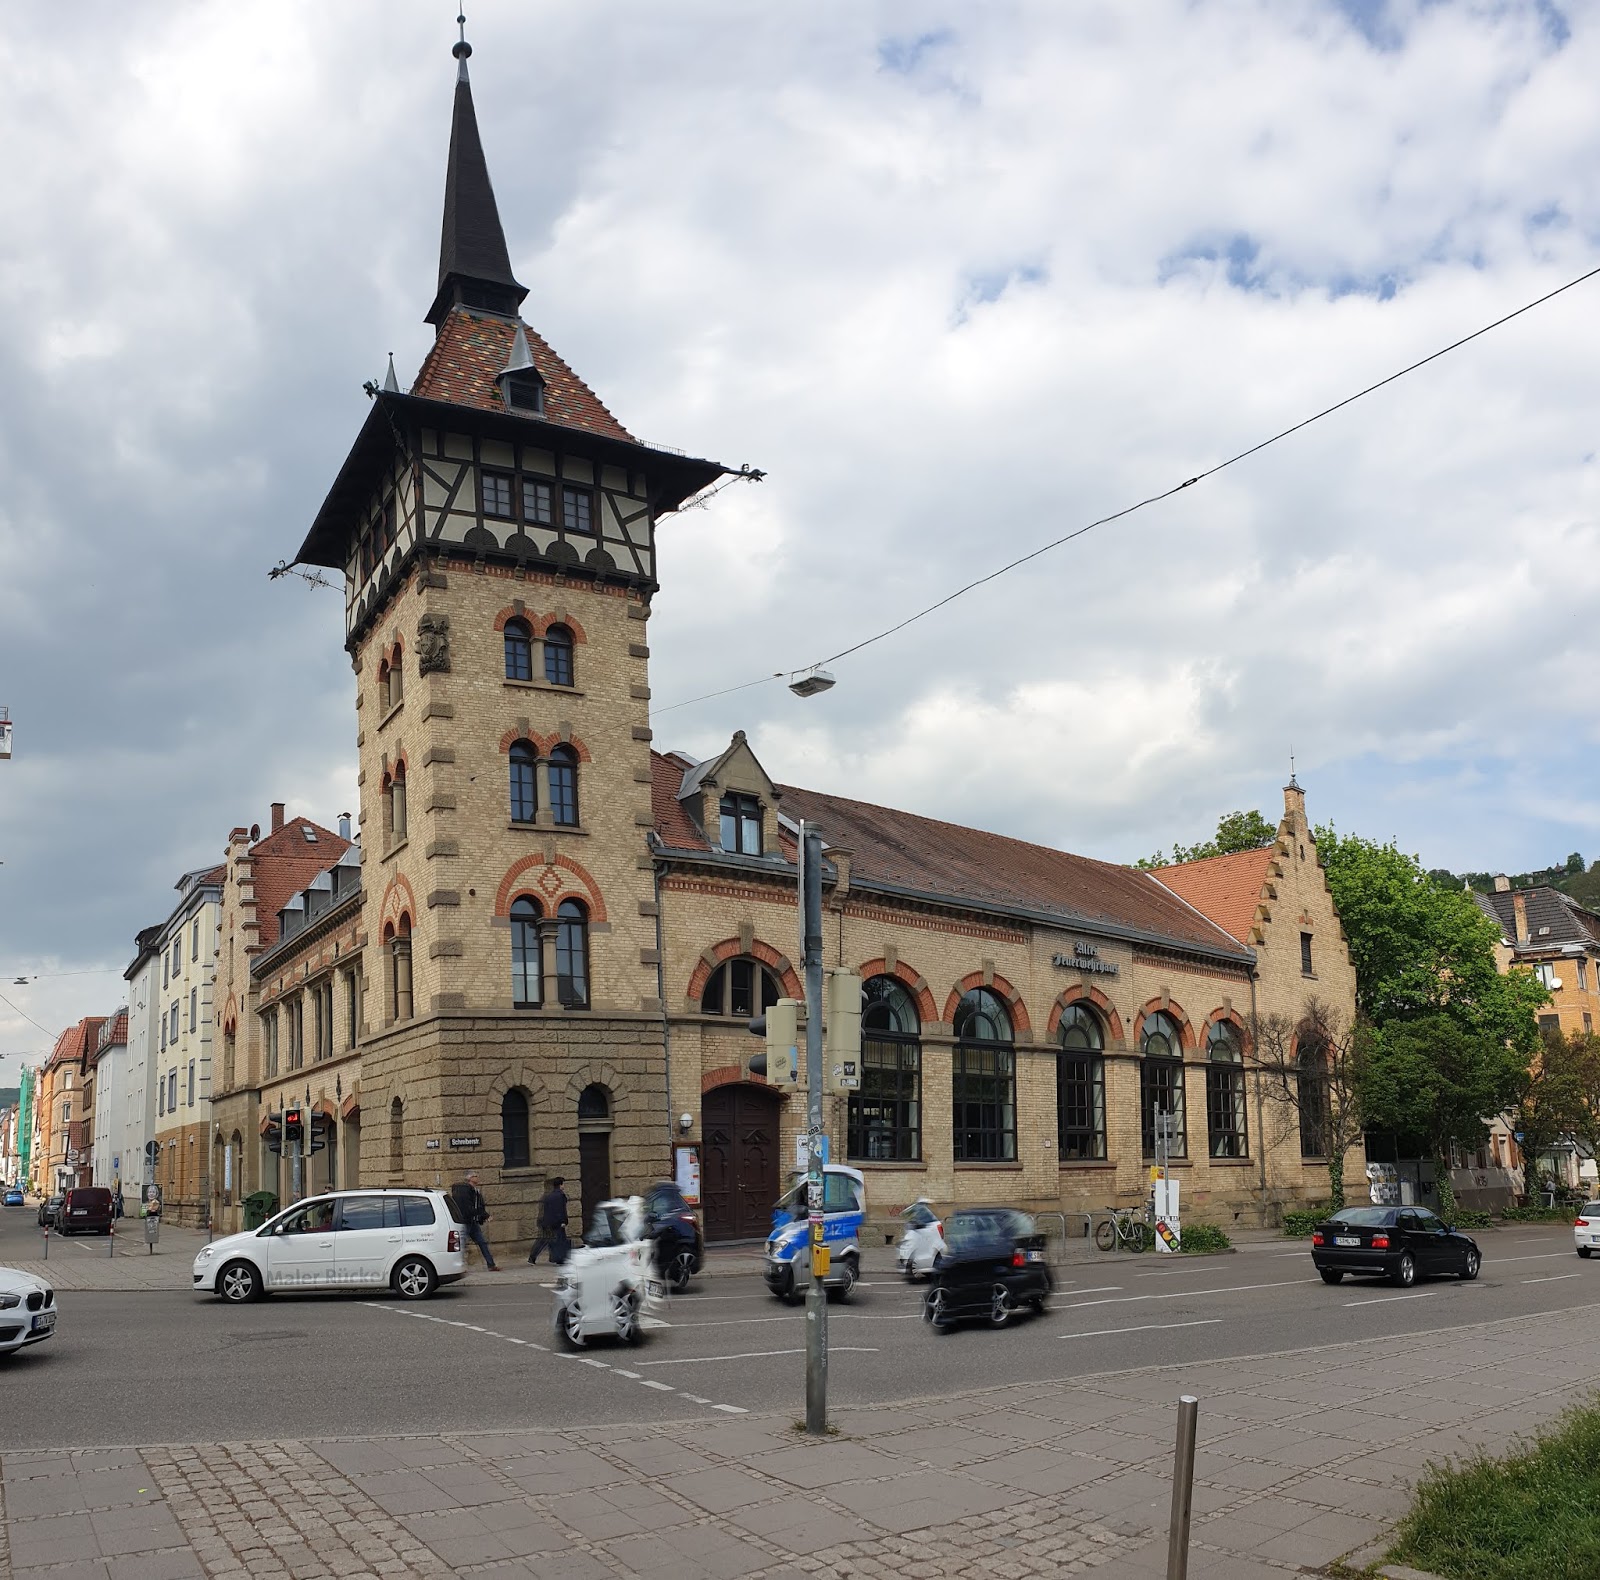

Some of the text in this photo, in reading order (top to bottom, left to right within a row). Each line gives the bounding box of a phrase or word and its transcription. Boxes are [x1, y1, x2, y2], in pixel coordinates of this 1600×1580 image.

[1076, 941, 1099, 956] Altes
[1053, 953, 1121, 974] Feuerwehrhaus
[267, 1266, 389, 1286] Maler Rücker
